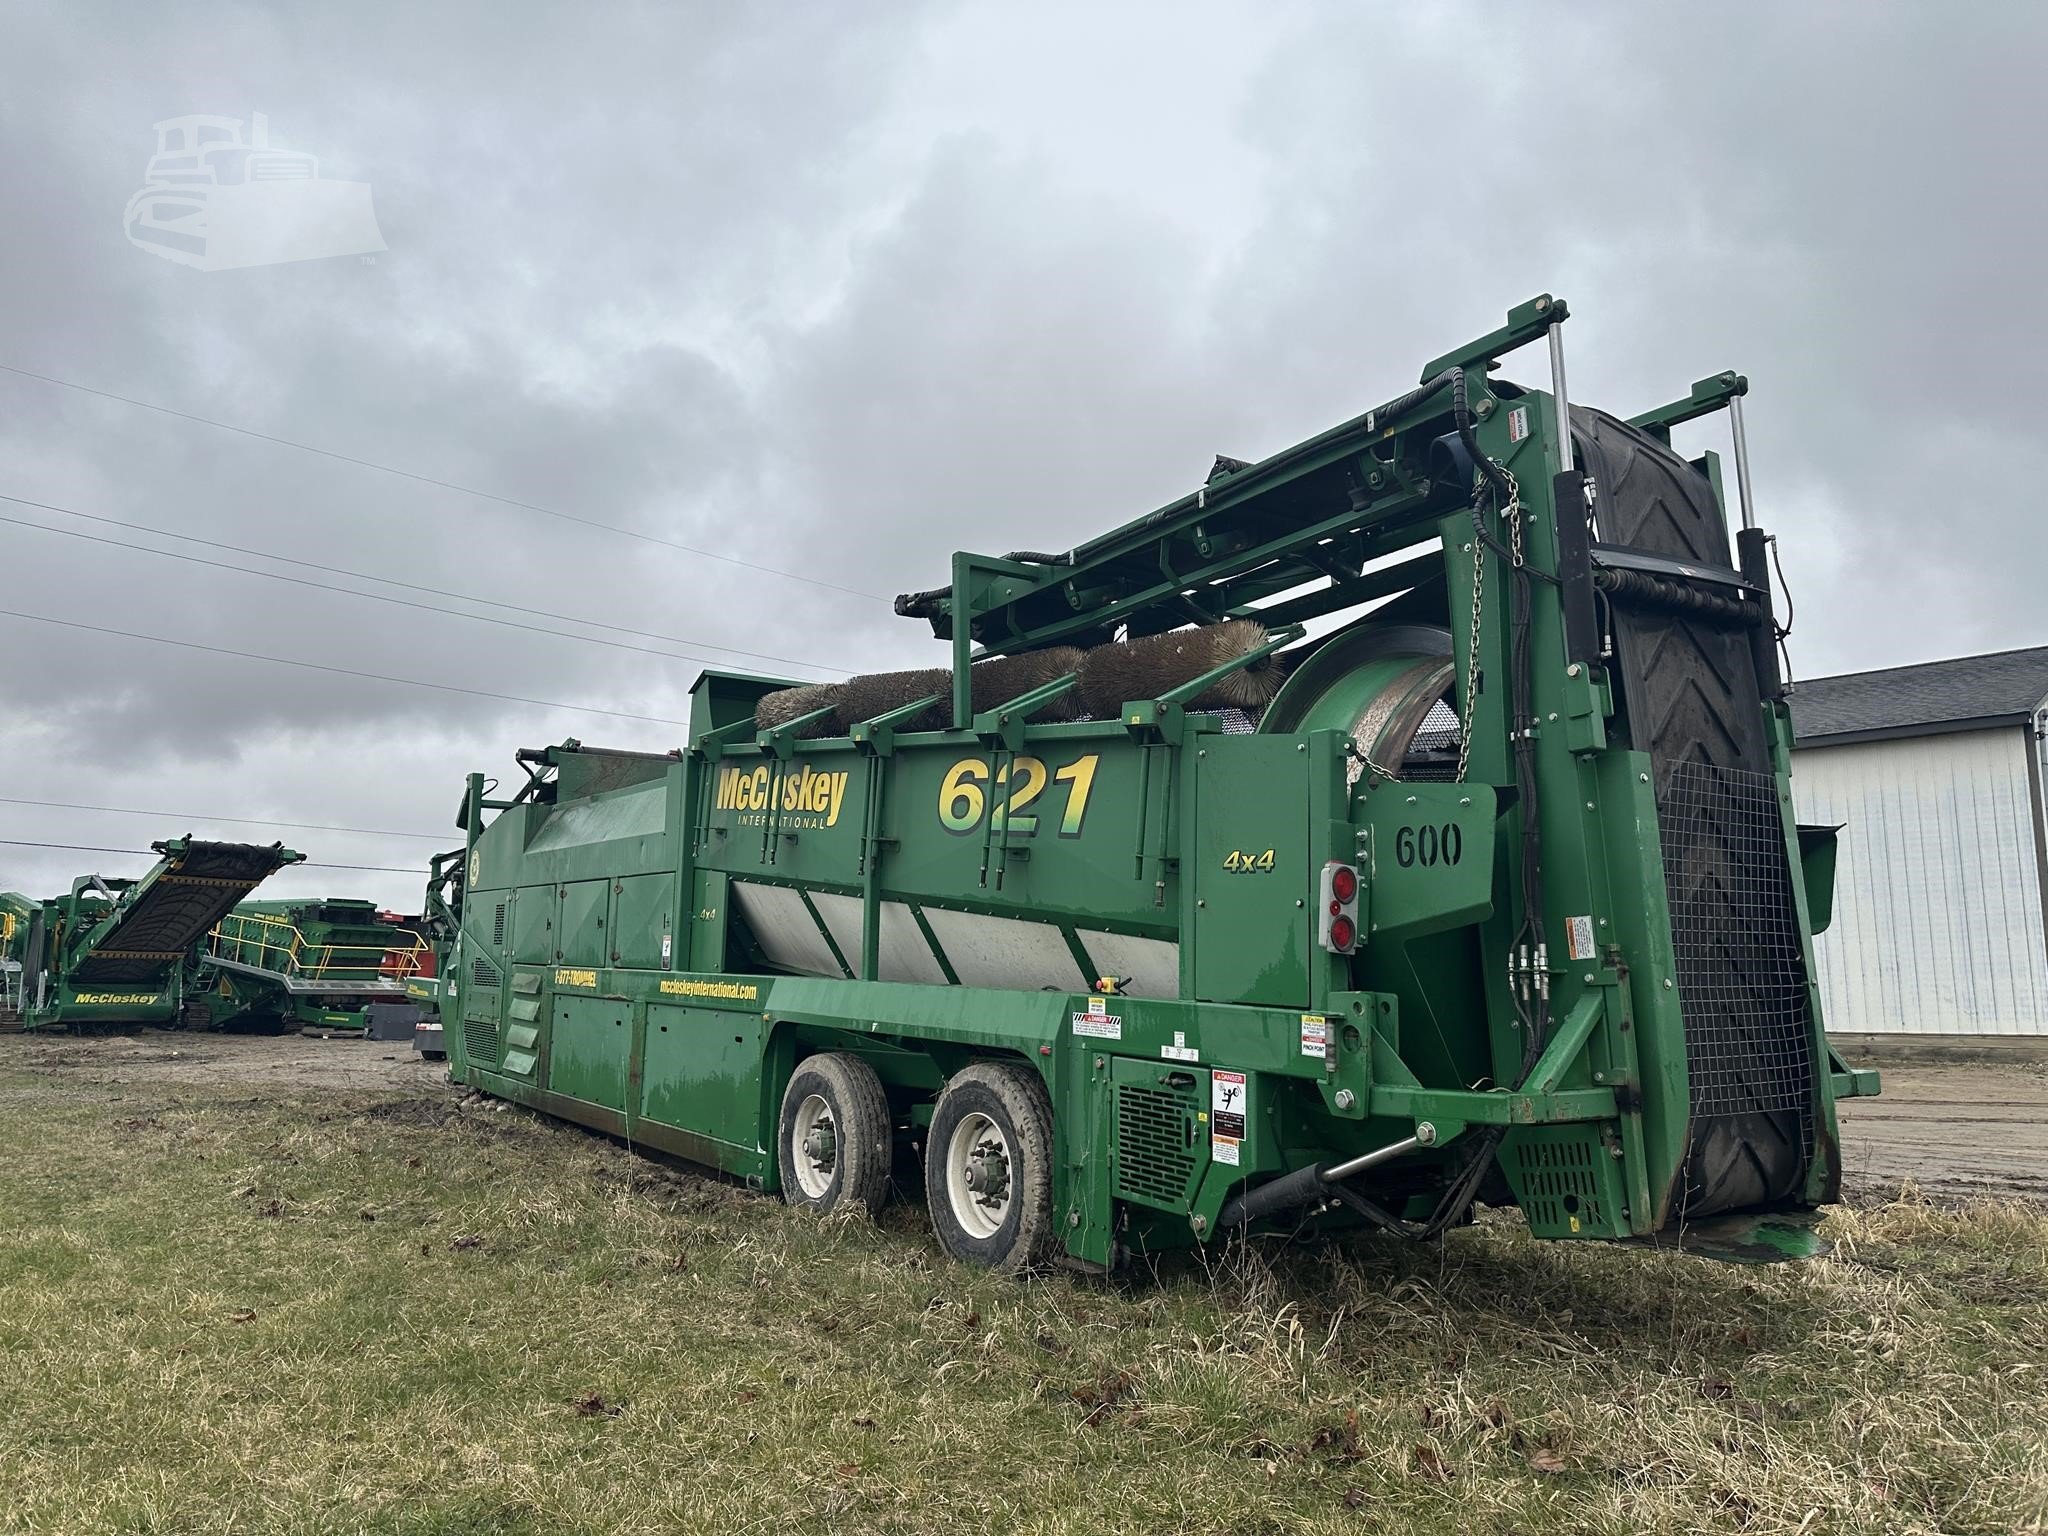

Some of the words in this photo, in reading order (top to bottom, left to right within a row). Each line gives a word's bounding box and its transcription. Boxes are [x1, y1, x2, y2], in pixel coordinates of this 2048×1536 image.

[938, 754, 1100, 837] 621
[1396, 823, 1462, 868] 600
[1222, 849, 1276, 874] 4x4
[699, 908, 716, 920] 4x4
[75, 993, 158, 1005] McCloskey
[660, 979, 757, 1000] mccloskeyinternational.com
[1221, 1073, 1243, 1083] DANGER
